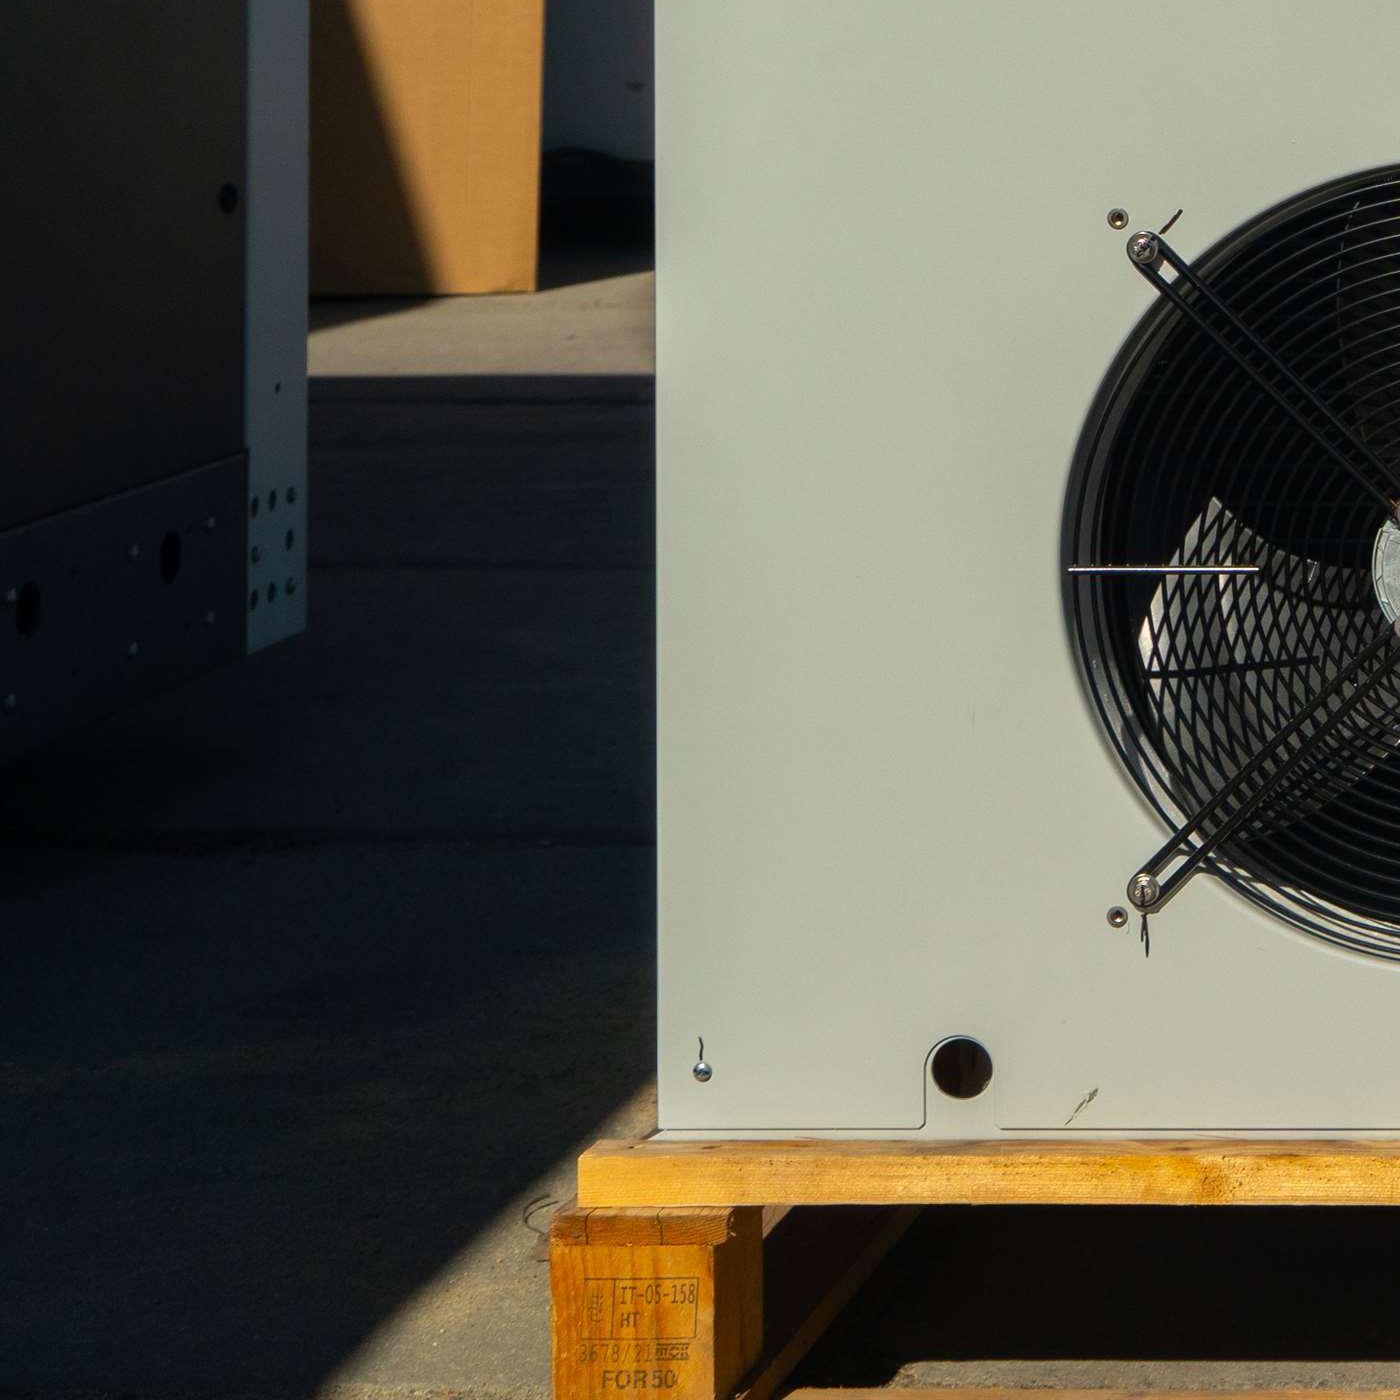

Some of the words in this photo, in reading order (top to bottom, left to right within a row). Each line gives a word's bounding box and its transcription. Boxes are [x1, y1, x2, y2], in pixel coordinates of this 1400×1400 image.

[620, 1283, 696, 1305] IT-05-158
[620, 1311, 640, 1328] HT
[602, 1369, 648, 1390] FOR
